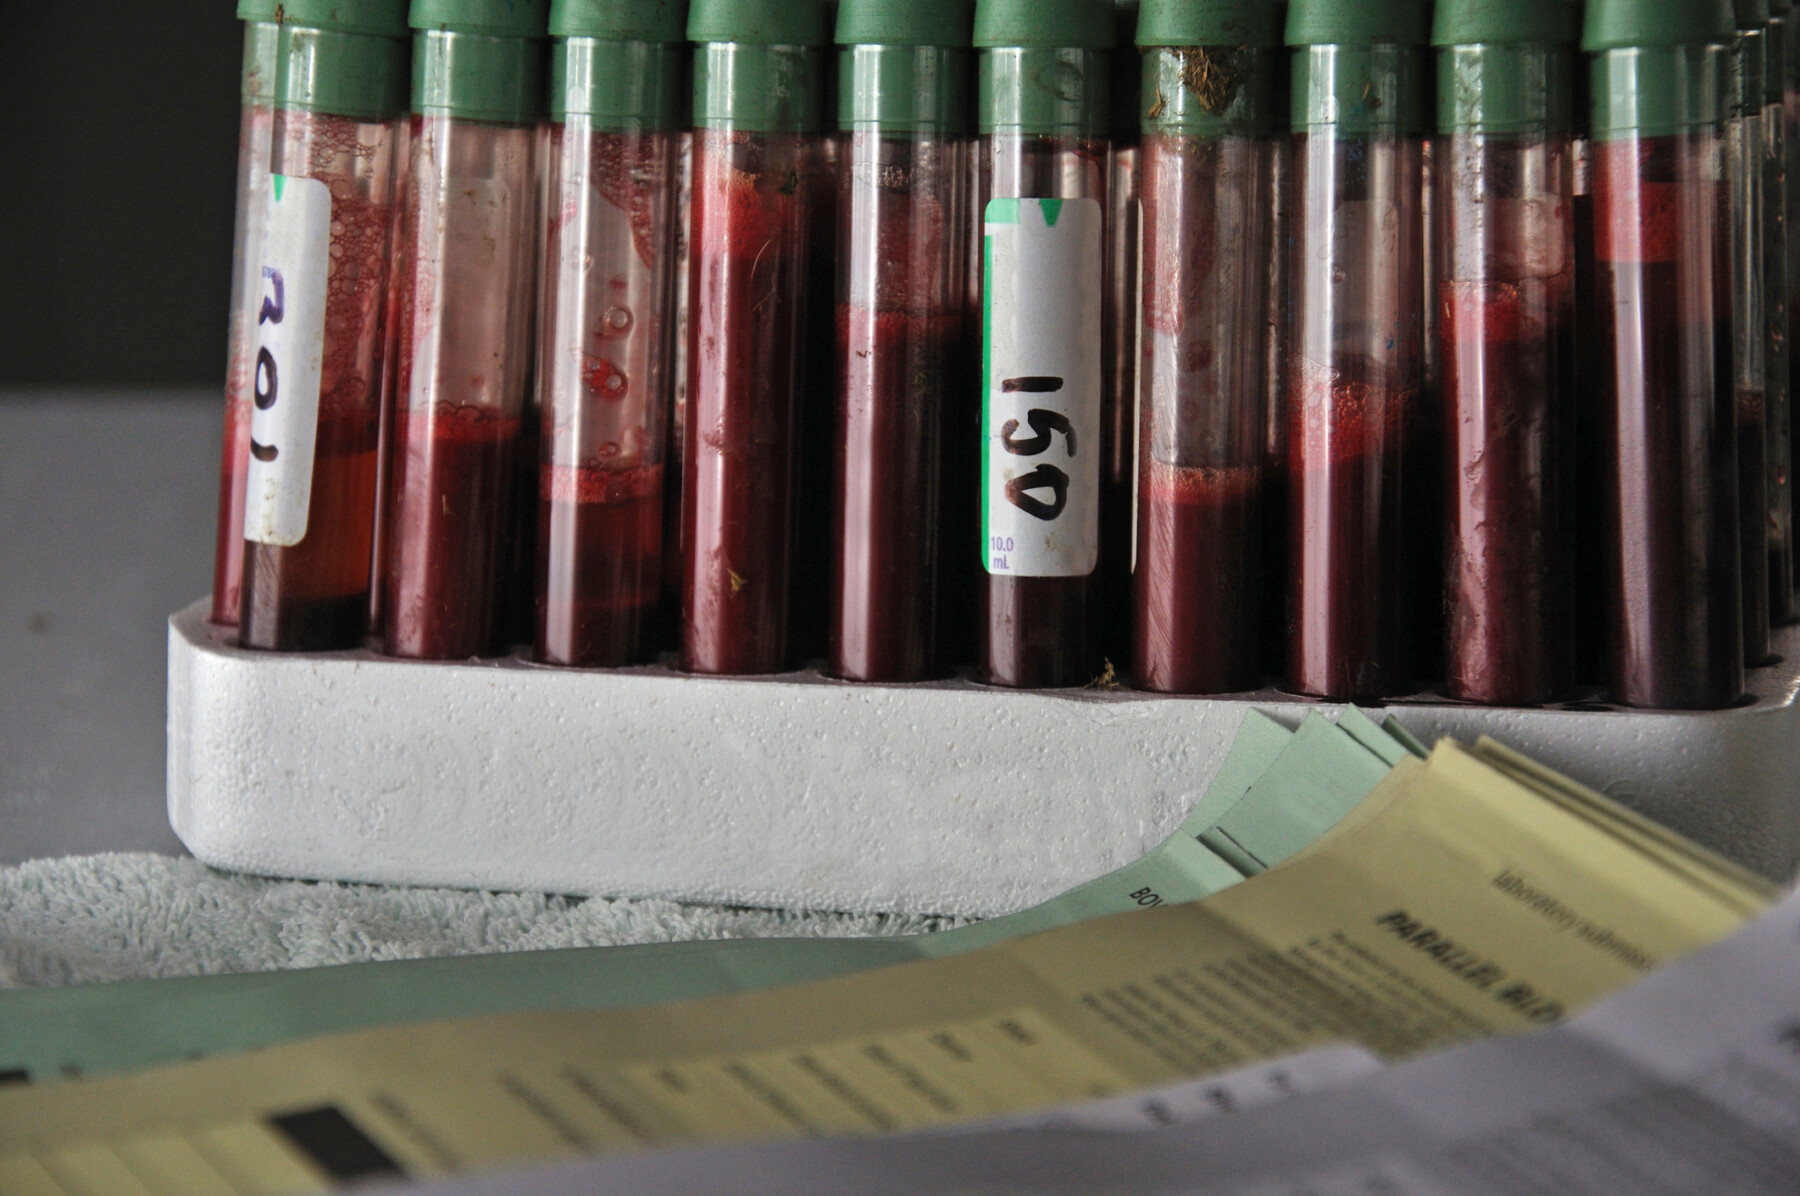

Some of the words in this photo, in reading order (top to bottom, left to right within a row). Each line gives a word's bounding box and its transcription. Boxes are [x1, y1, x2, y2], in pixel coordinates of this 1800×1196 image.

[1001, 376, 1077, 521] 150
[991, 536, 1014, 552] 10.0
[993, 554, 1010, 569] mL
